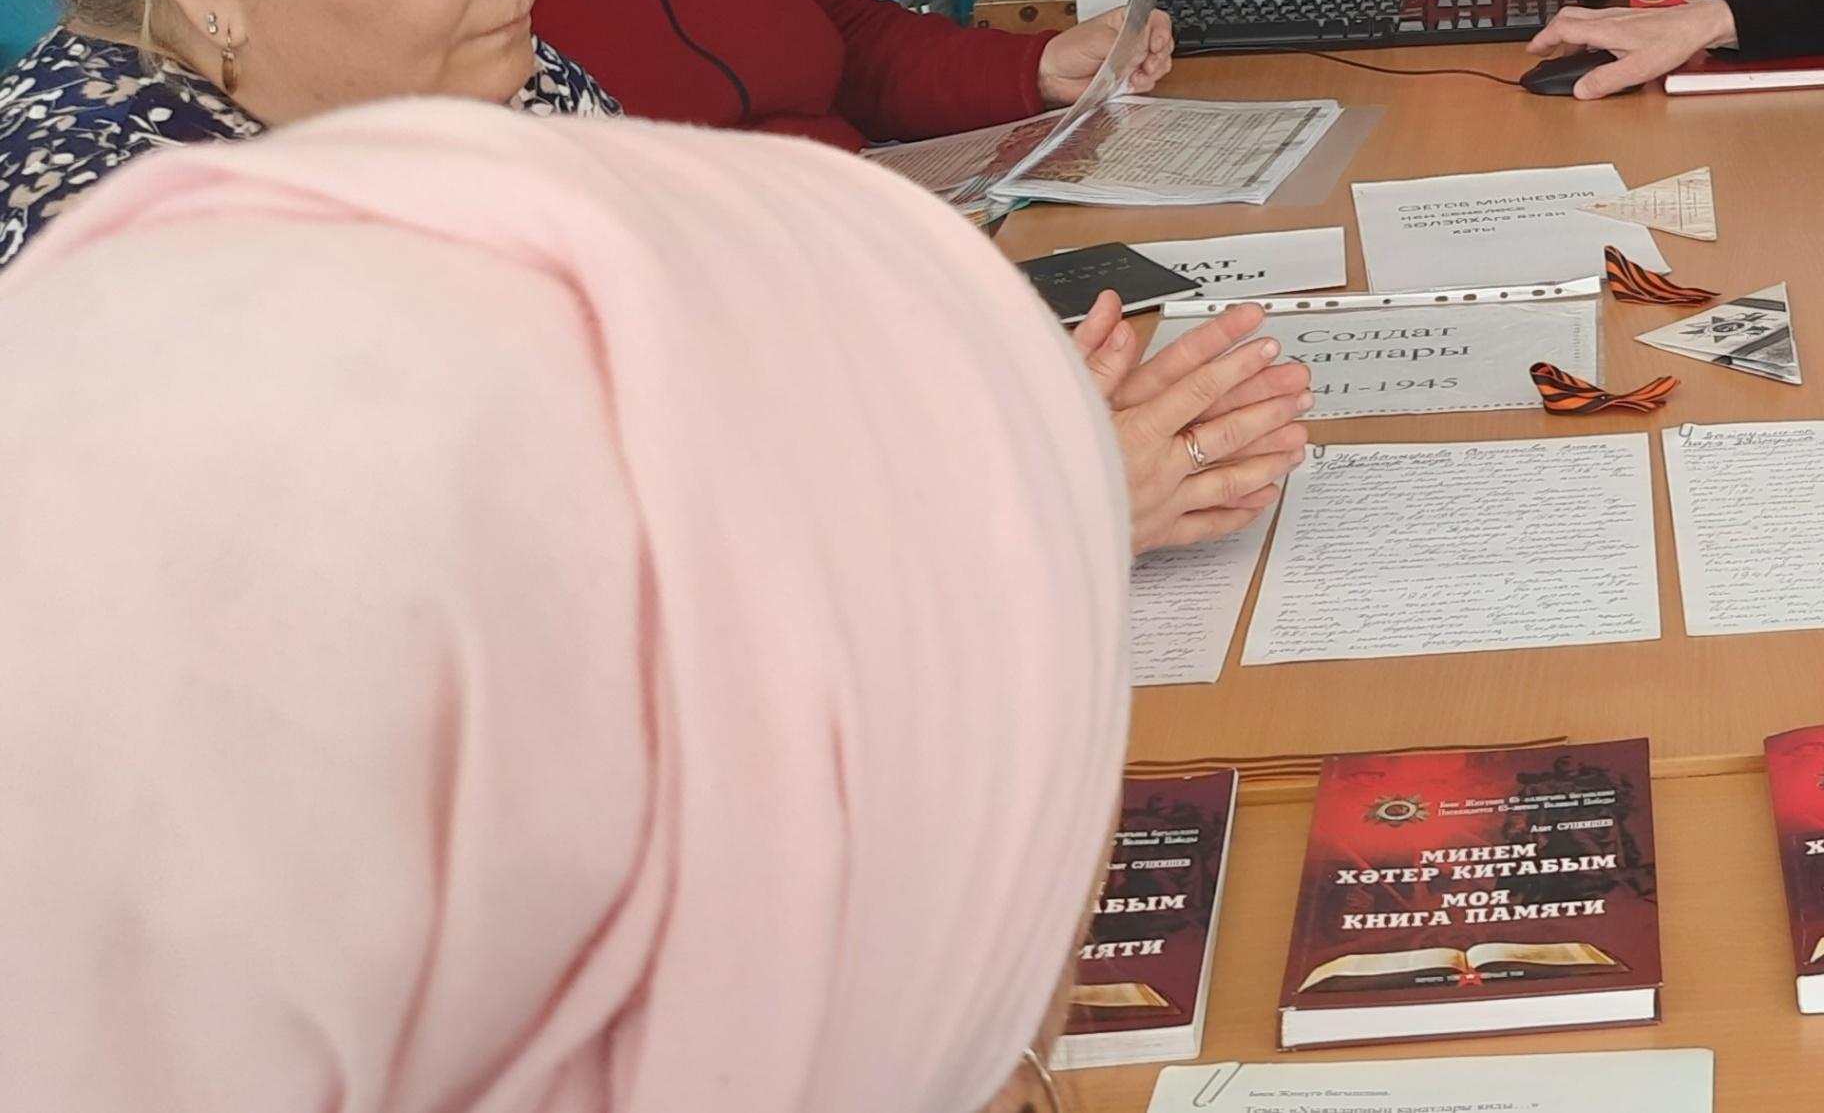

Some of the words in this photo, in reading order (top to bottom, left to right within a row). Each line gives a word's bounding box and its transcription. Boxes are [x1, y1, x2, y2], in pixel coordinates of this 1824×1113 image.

[1297, 327, 1457, 343] Солдат
[1286, 345, 1472, 363] хатлары
[1420, 843, 1537, 864] МИНЕМ
[1335, 868, 1440, 885] ХӘТЕР
[1451, 854, 1617, 880] КИТАБЫМ
[1440, 889, 1511, 908] МОЯ
[1341, 909, 1452, 930] КНИГА
[1465, 899, 1606, 924] ПАМЯТИ
